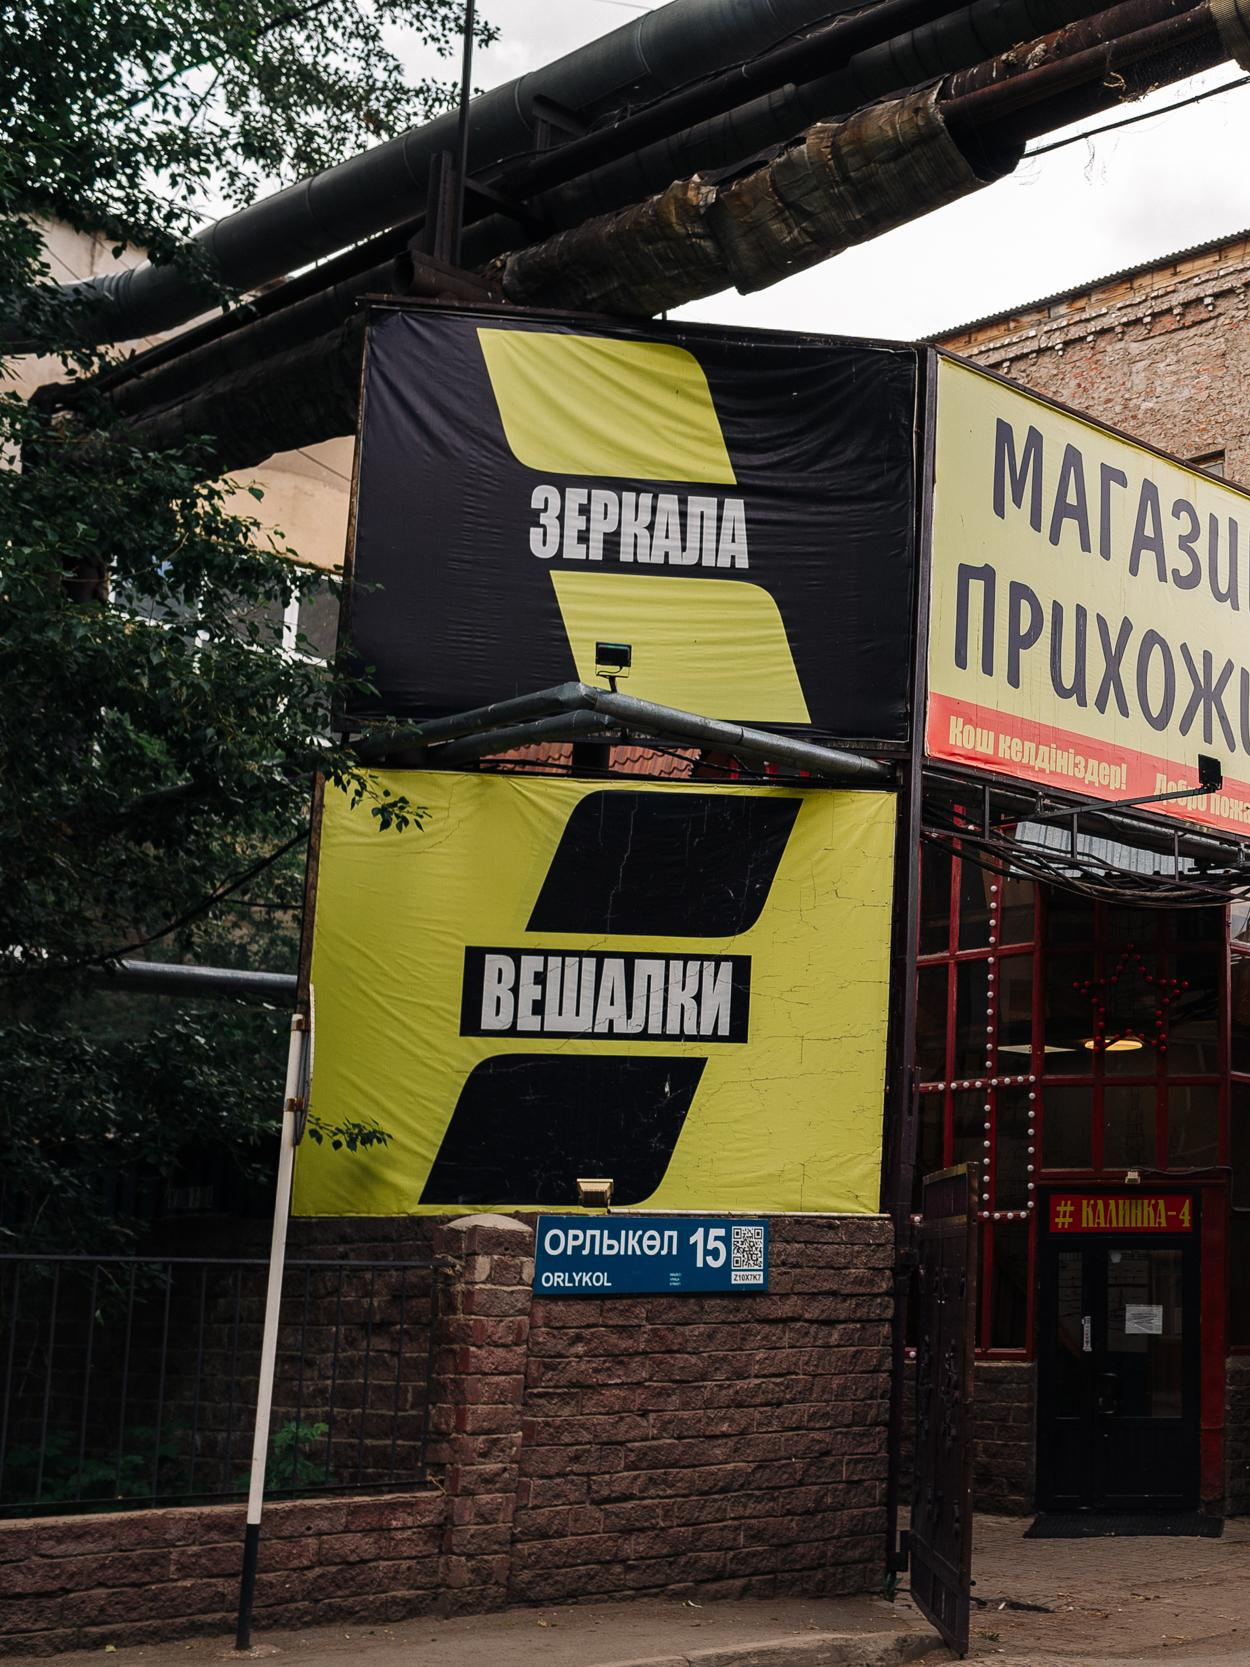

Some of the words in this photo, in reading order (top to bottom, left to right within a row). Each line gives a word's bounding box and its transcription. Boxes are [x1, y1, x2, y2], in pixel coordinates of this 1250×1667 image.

[529, 485, 749, 569] ЗЕРКАЛА
[949, 716, 994, 754] Кош
[999, 734, 1127, 789] келдініздер!
[480, 953, 732, 1037] ВЕШАЛКИ
[1081, 1199, 1191, 1227] КАЛИНКА-4
[544, 1229, 677, 1255] ОРЛЫКӨЛ
[689, 1227, 727, 1268] 15
[541, 1272, 612, 1287] ORLYKOL
[734, 1273, 761, 1282] Z10X7K7
